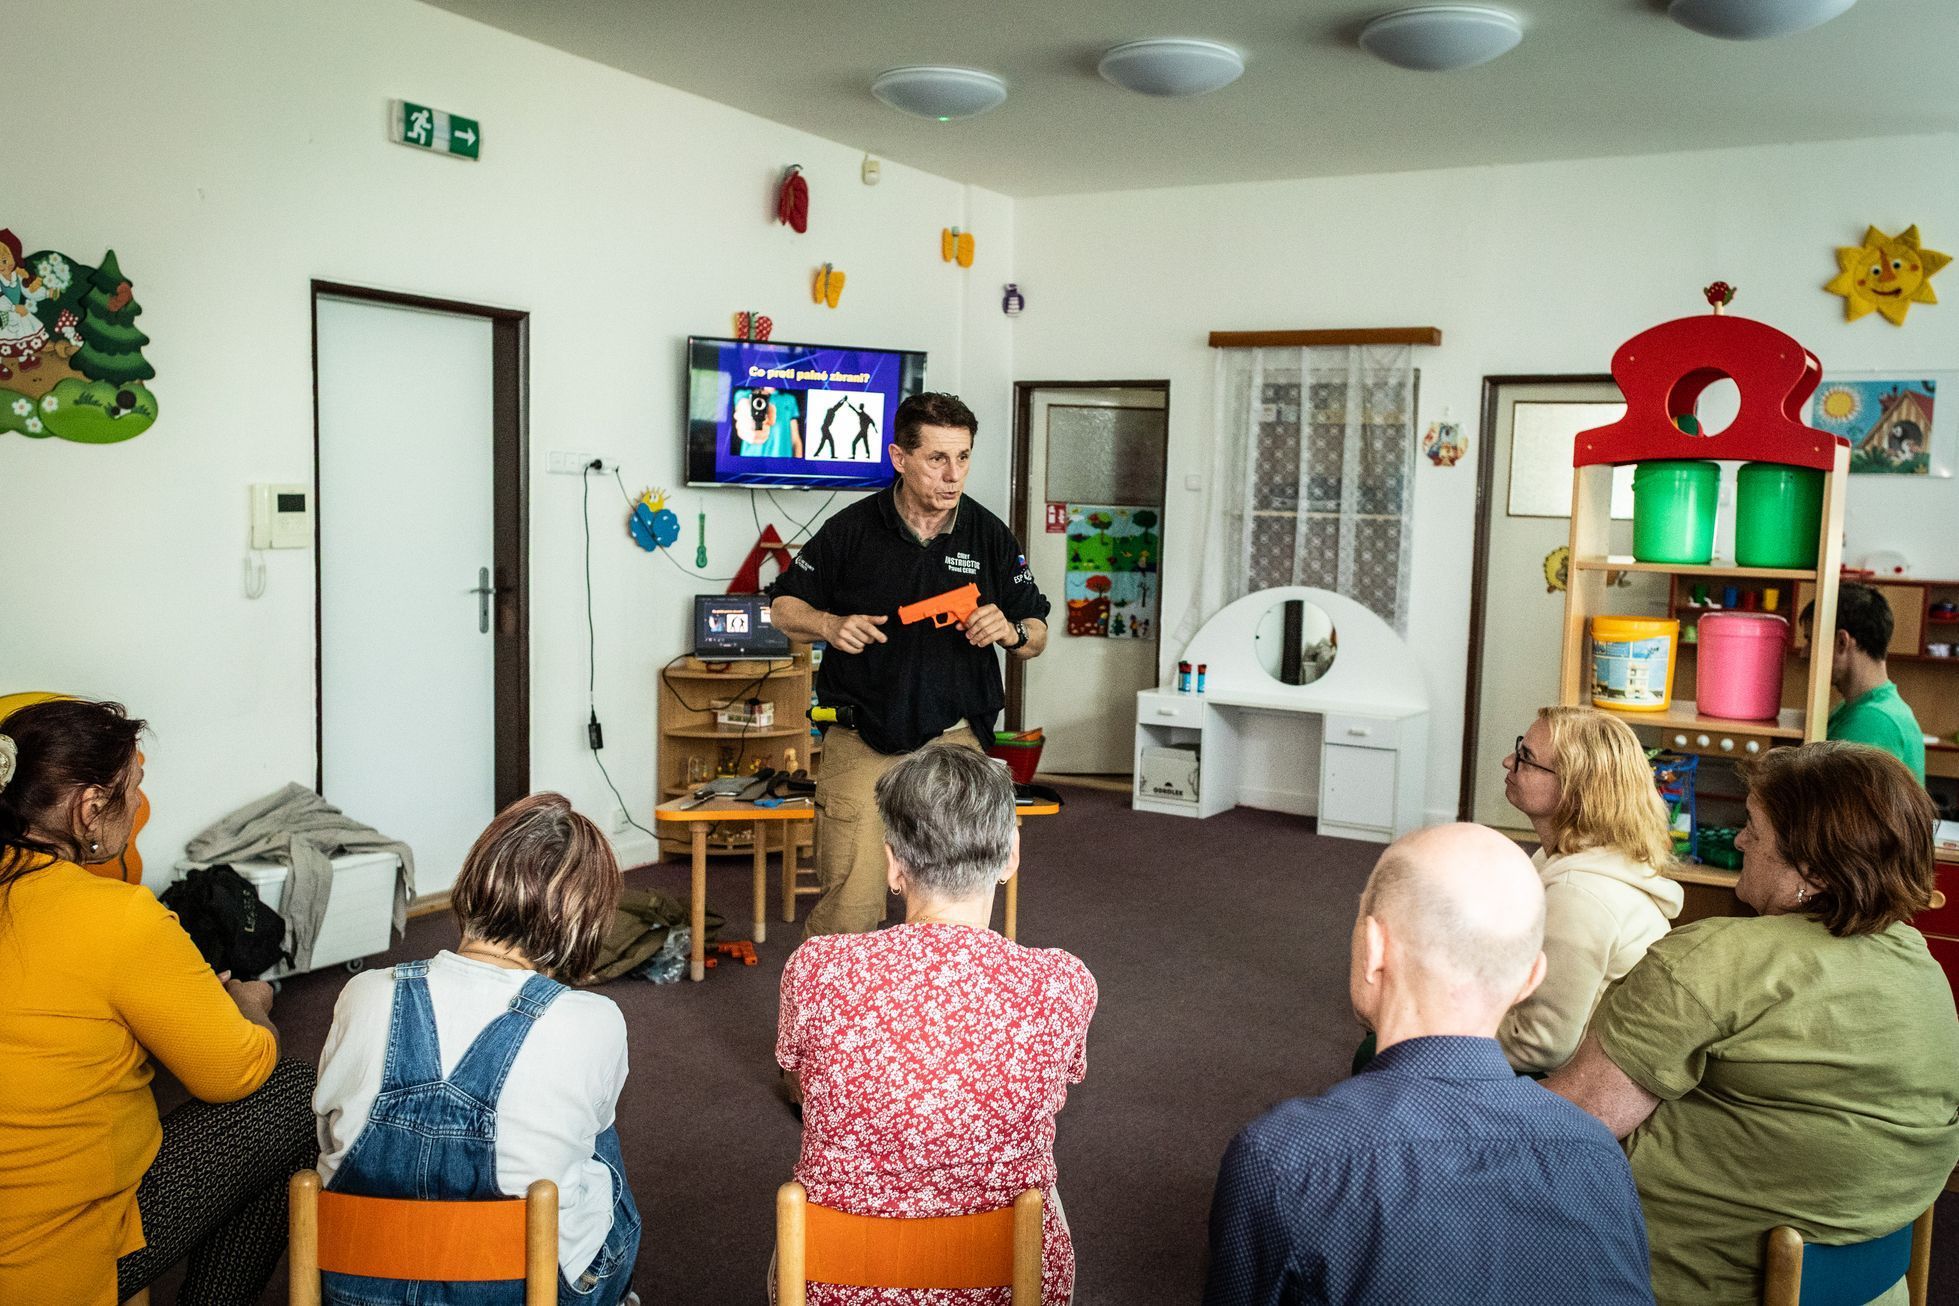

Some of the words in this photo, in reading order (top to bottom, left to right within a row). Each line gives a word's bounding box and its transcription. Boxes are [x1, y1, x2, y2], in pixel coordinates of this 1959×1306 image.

[749, 366, 765, 377] Co
[767, 369, 795, 380] proti
[945, 555, 980, 570] INSTRUCTOR
[1013, 574, 1024, 584] ESP
